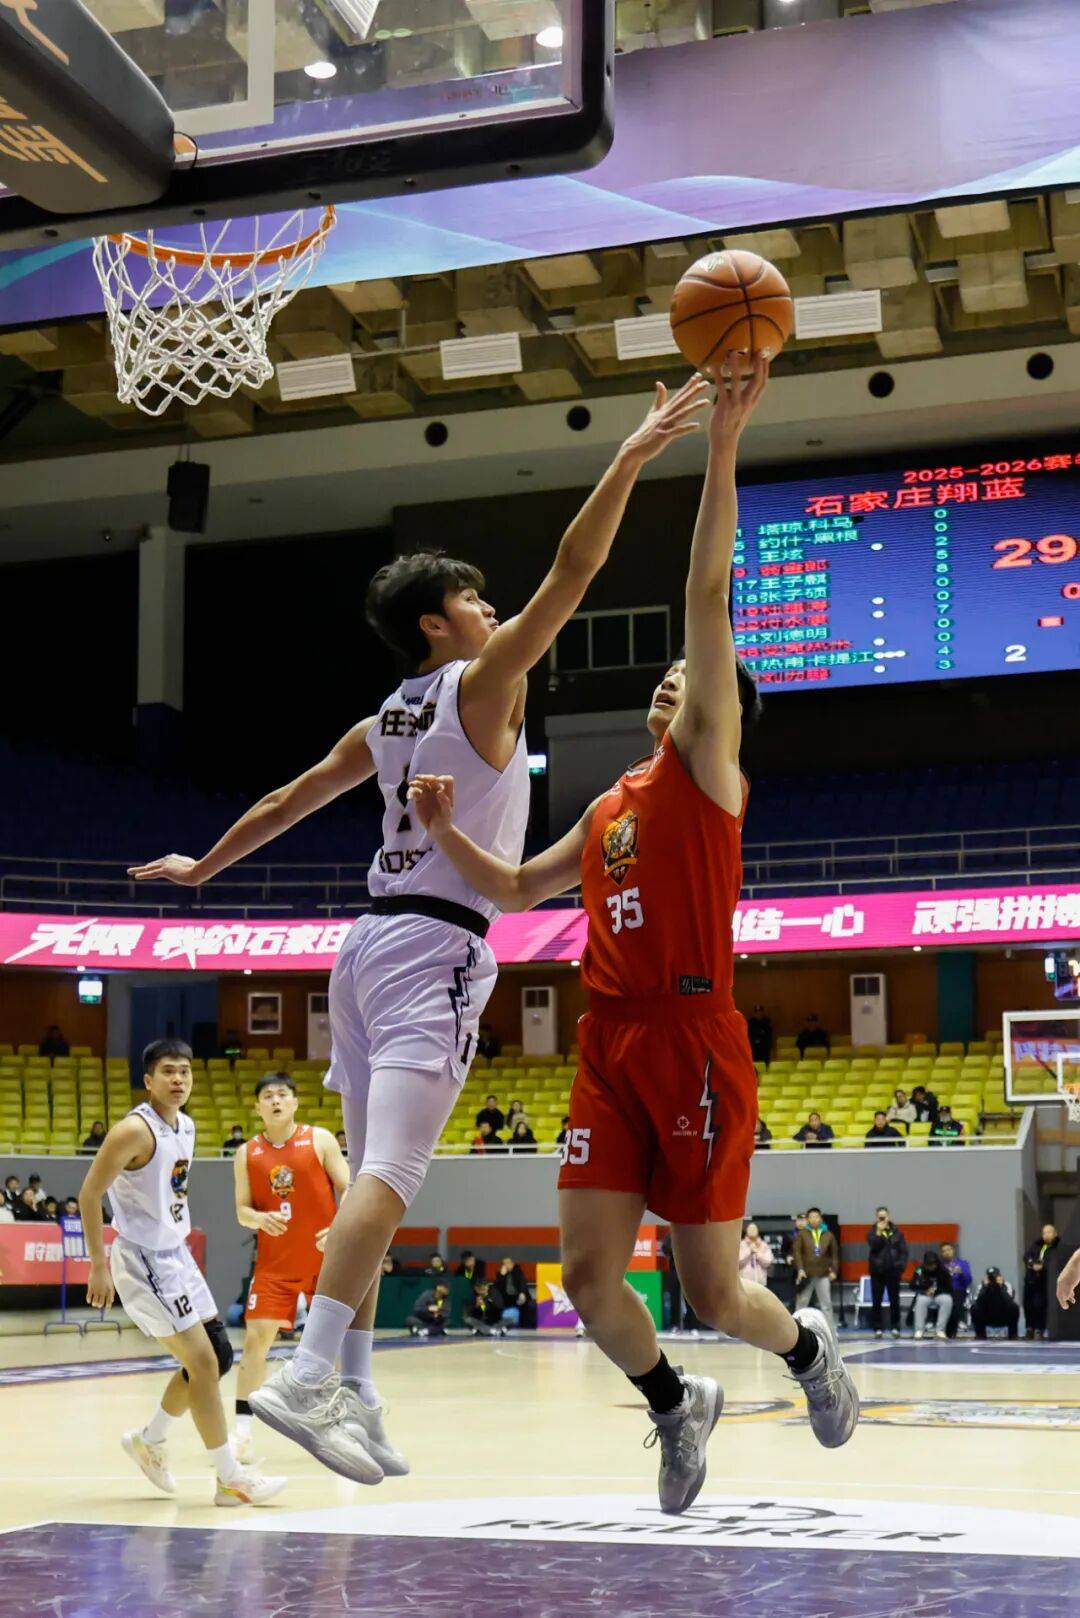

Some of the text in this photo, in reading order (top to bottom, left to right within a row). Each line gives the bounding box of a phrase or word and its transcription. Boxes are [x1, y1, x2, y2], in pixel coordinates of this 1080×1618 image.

[903, 452, 1080, 484] 2025-2026赛
[805, 476, 1027, 517] 石家庄翔蓝
[934, 508, 948, 519] 0
[934, 522, 948, 533] 0
[935, 535, 949, 547] 2
[993, 534, 1078, 570] 29
[936, 549, 949, 560] 5
[735, 579, 758, 591] 17
[936, 563, 949, 574] 8
[736, 592, 759, 604] 18
[936, 576, 950, 587] 0
[936, 590, 950, 601] 0
[937, 603, 951, 614] 7
[734, 634, 758, 646] 24
[937, 617, 951, 628] 0
[937, 631, 951, 642] 0
[937, 645, 952, 656] 4
[1004, 644, 1027, 663] 2
[938, 659, 952, 670] 3
[605, 886, 645, 936] 35
[4, 918, 145, 964] 无限
[172, 1294, 194, 1319] 12
[461, 1518, 968, 1544] RIGORER
